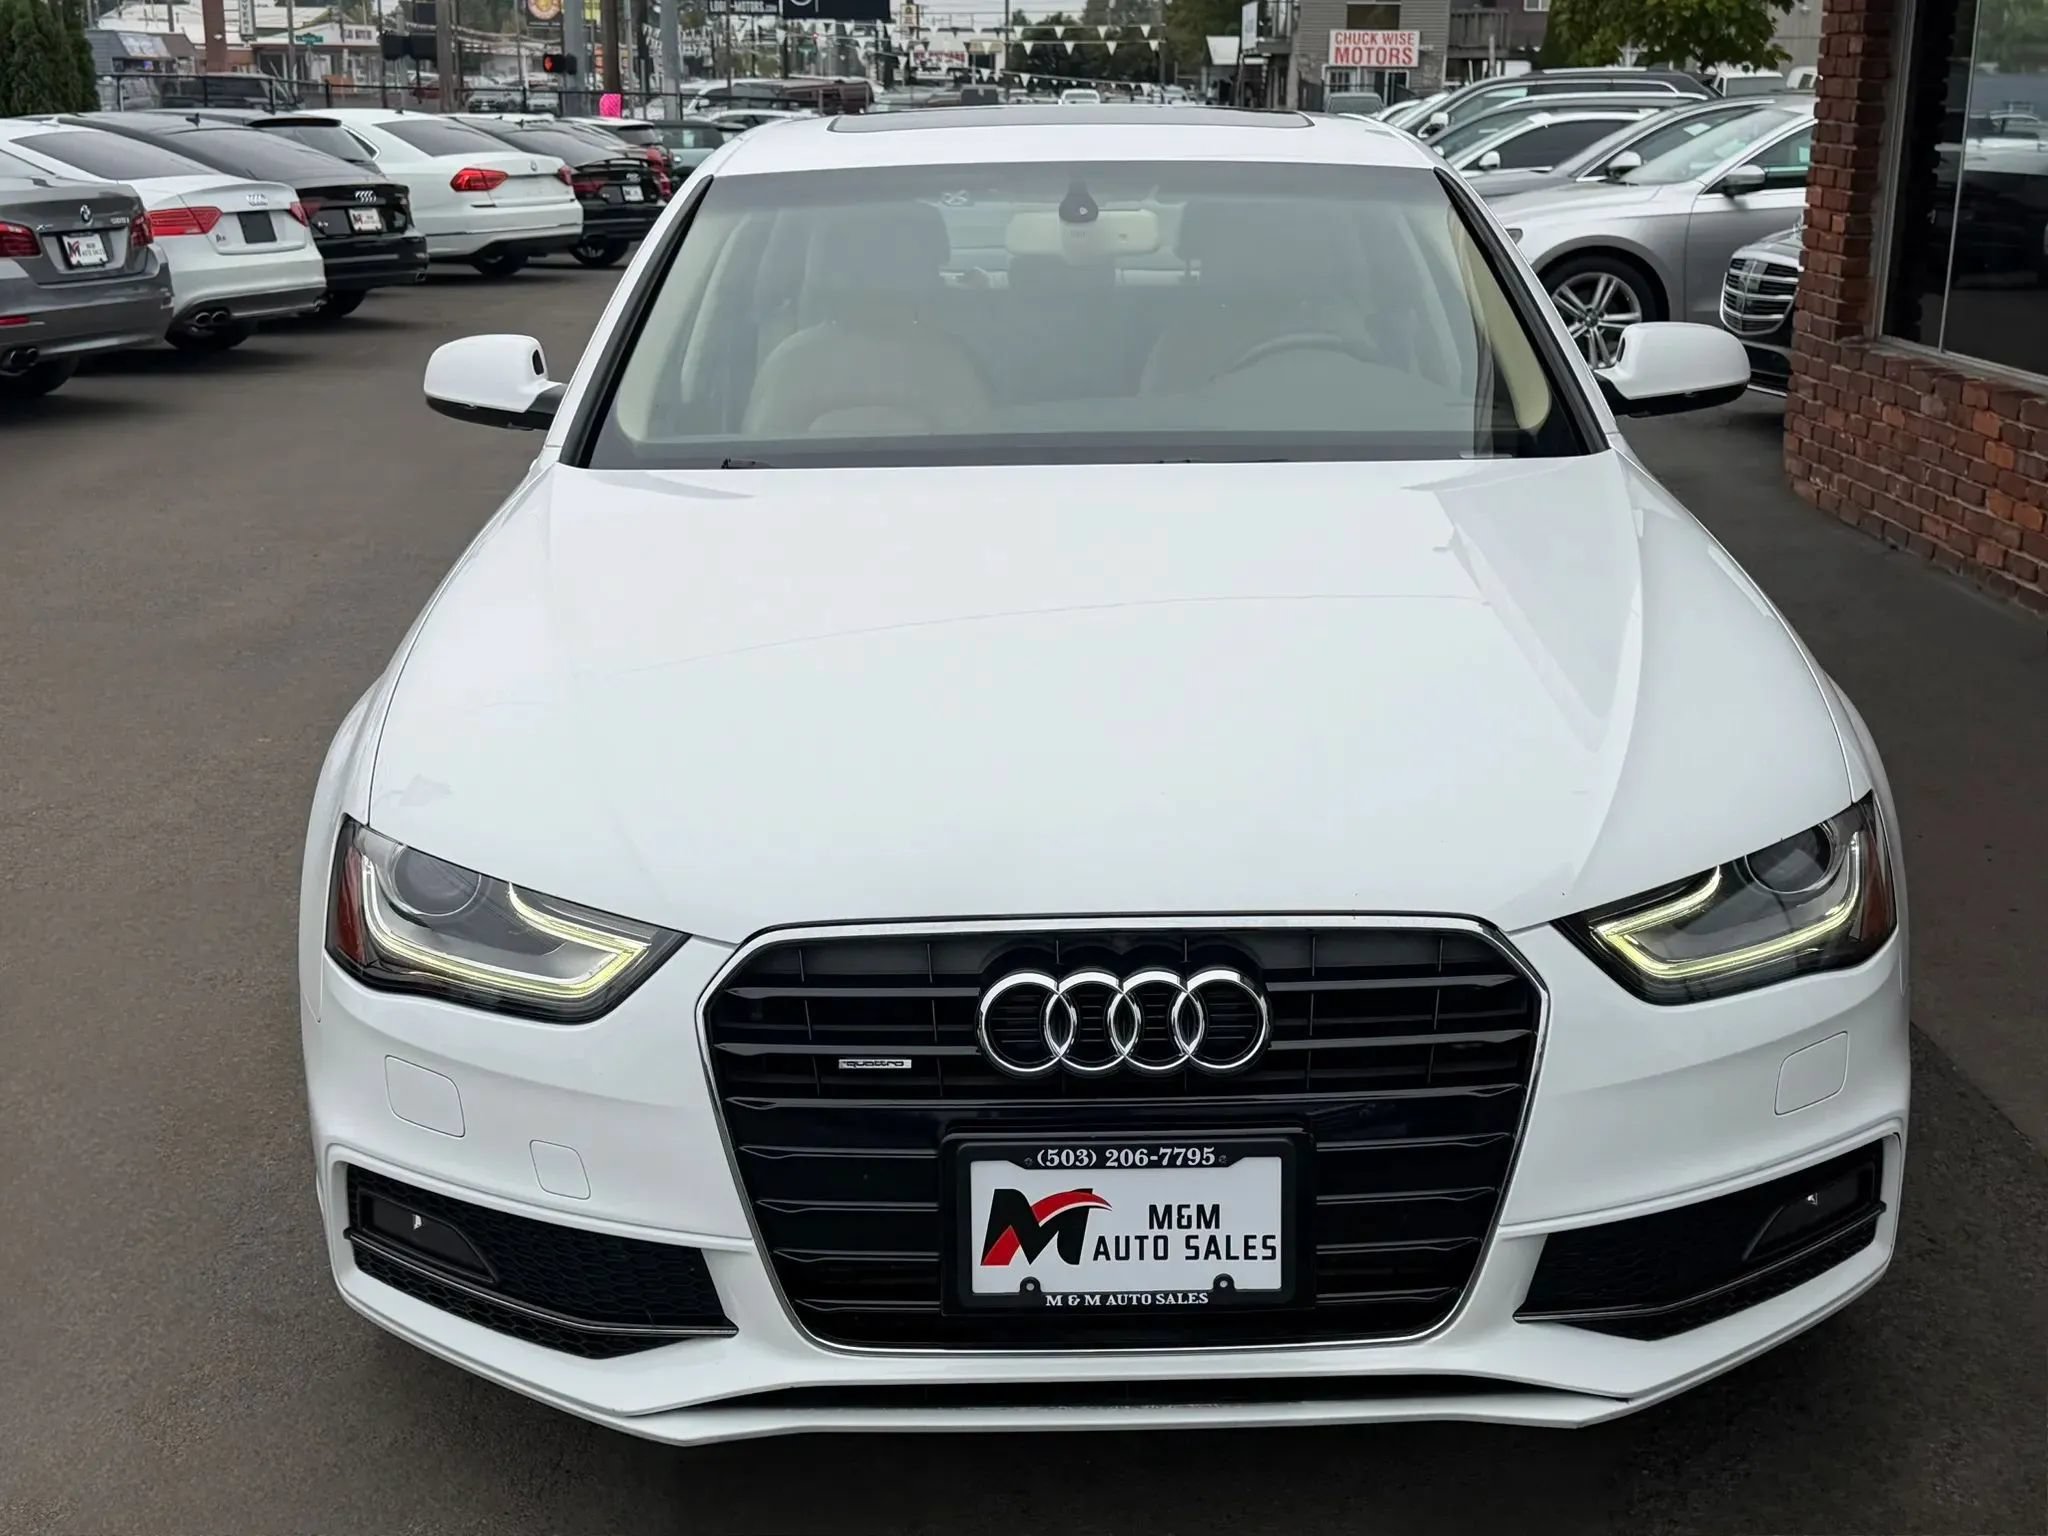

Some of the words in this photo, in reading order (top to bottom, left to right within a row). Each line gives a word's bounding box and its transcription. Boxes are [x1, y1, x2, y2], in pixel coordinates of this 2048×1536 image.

[1335, 32, 1377, 45] CHUCK
[1382, 32, 1415, 45] WISE
[1335, 47, 1413, 65] MOTORS
[846, 1061, 904, 1069] quattro
[1037, 1149, 1097, 1167] (503)
[1105, 1146, 1216, 1167] 206-7795
[1148, 1203, 1221, 1230] M&M
[1092, 1235, 1169, 1261] AUTO
[1184, 1234, 1277, 1261] SALES
[1045, 1294, 1063, 1306] M
[1067, 1295, 1081, 1306] &
[1083, 1294, 1102, 1306] M
[1105, 1293, 1152, 1306] AUTO
[1155, 1292, 1209, 1305] SALES
